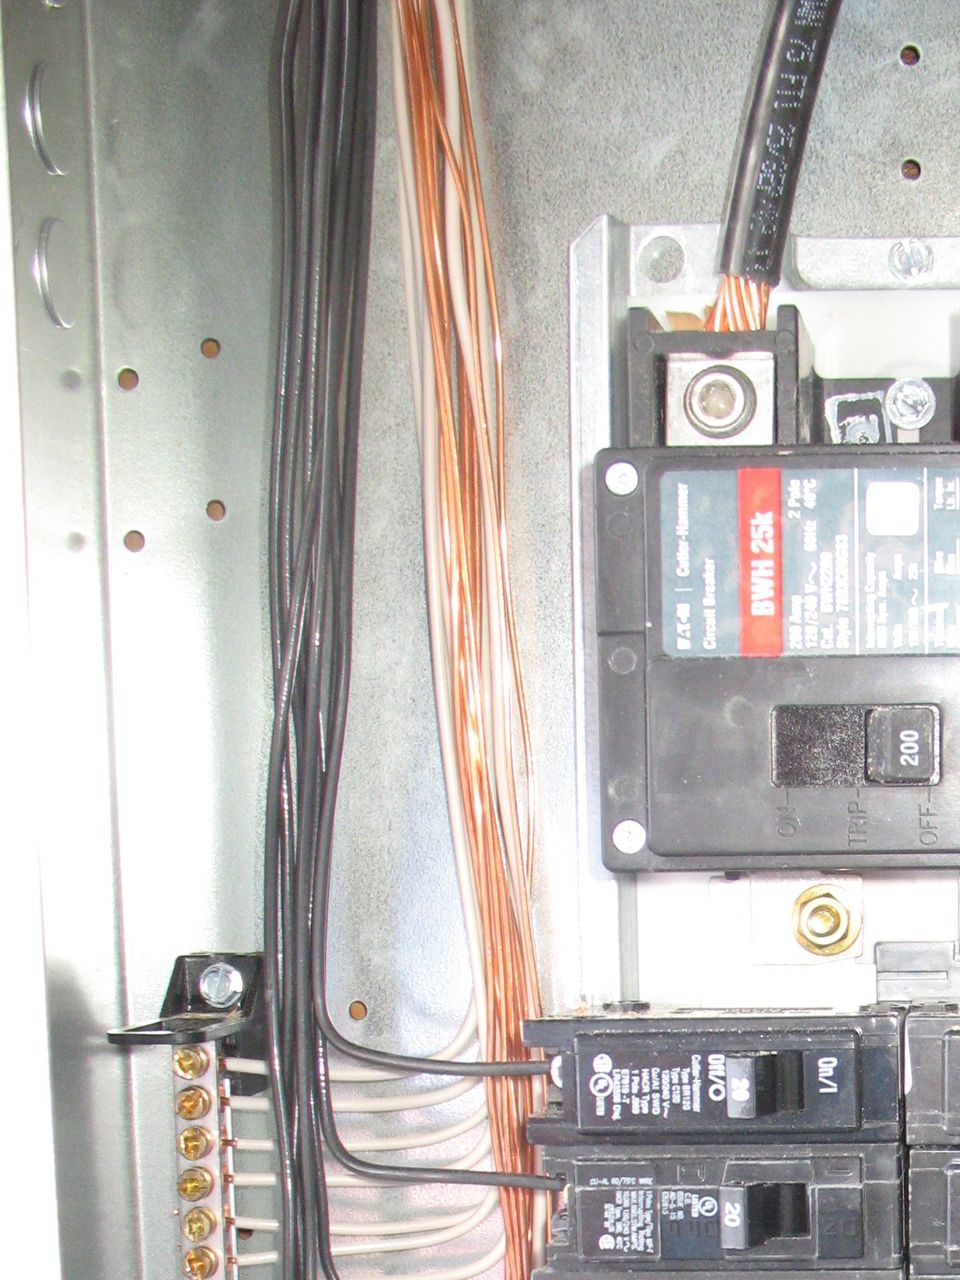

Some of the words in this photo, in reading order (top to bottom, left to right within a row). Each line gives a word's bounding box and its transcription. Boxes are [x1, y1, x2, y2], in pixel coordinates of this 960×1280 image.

[675, 482, 691, 577] Cutler-Hammer
[750, 511, 775, 554] 25k
[702, 557, 717, 606] Breaker
[750, 559, 775, 616] BWH
[703, 608, 717, 650] Circuit
[899, 729, 919, 766] 200
[731, 1076, 750, 1101] 20
[725, 1202, 741, 1228] 20
